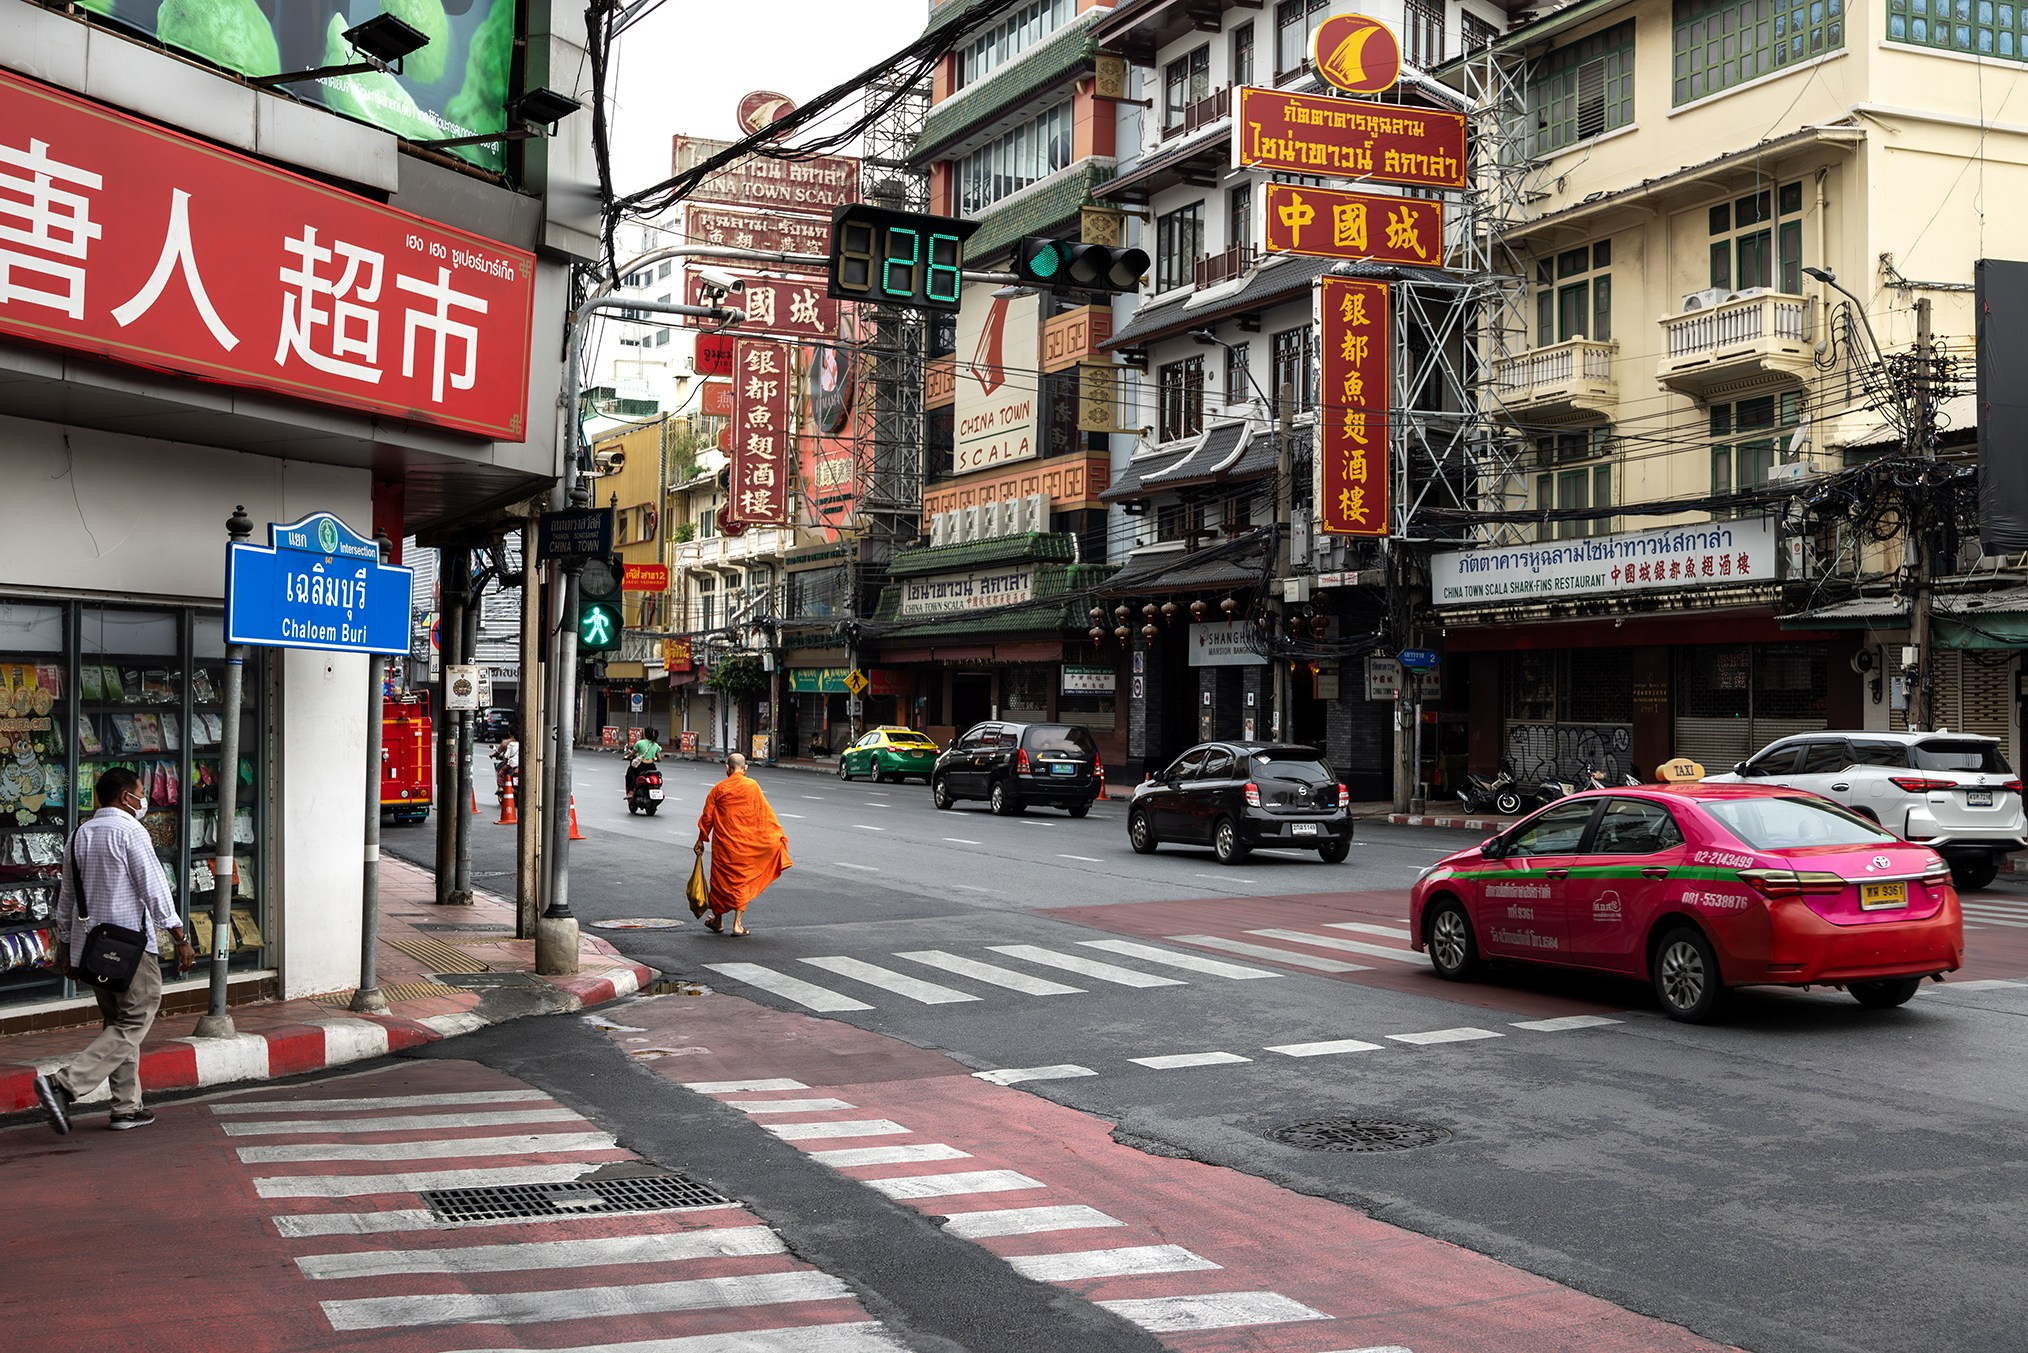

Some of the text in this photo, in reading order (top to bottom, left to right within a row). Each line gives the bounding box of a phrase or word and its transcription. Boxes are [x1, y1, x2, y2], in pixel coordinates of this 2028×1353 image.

[1284, 99, 1425, 139] ภัตตาคารหูฉลาม
[1249, 121, 1458, 179] ไชน่าทาวน์ สกาล่า
[695, 174, 847, 206] HINA TOWN SCALA
[1278, 192, 1426, 259] 中國城
[406, 234, 424, 252] เฮง
[429, 241, 447, 259] เฮง
[883, 226, 961, 302] 26
[960, 400, 1030, 437] CHINA TOWN
[1338, 292, 1372, 525] 銀都魚翅酒樓
[740, 349, 780, 517] 銀都魚翅酒樓
[960, 437, 1029, 470] SCALA
[289, 532, 307, 548] แยก
[340, 541, 376, 559] Intersection
[550, 540, 600, 553] CHINA TOWN
[286, 563, 367, 621] เฉลิมบุรี
[1443, 574, 1606, 599] CHINA TOWN SCALA SHARK-FINS RESTAURANT
[904, 600, 965, 614] CHINA TOWN SCALA
[282, 618, 367, 643] Chaloem Buri
[1429, 653, 1436, 663] 2
[1673, 764, 1695, 777] TAXI
[1694, 850, 1755, 869] 02-2143499
[1681, 891, 1749, 910] 081-5538876
[1882, 885, 1903, 897] 9361
